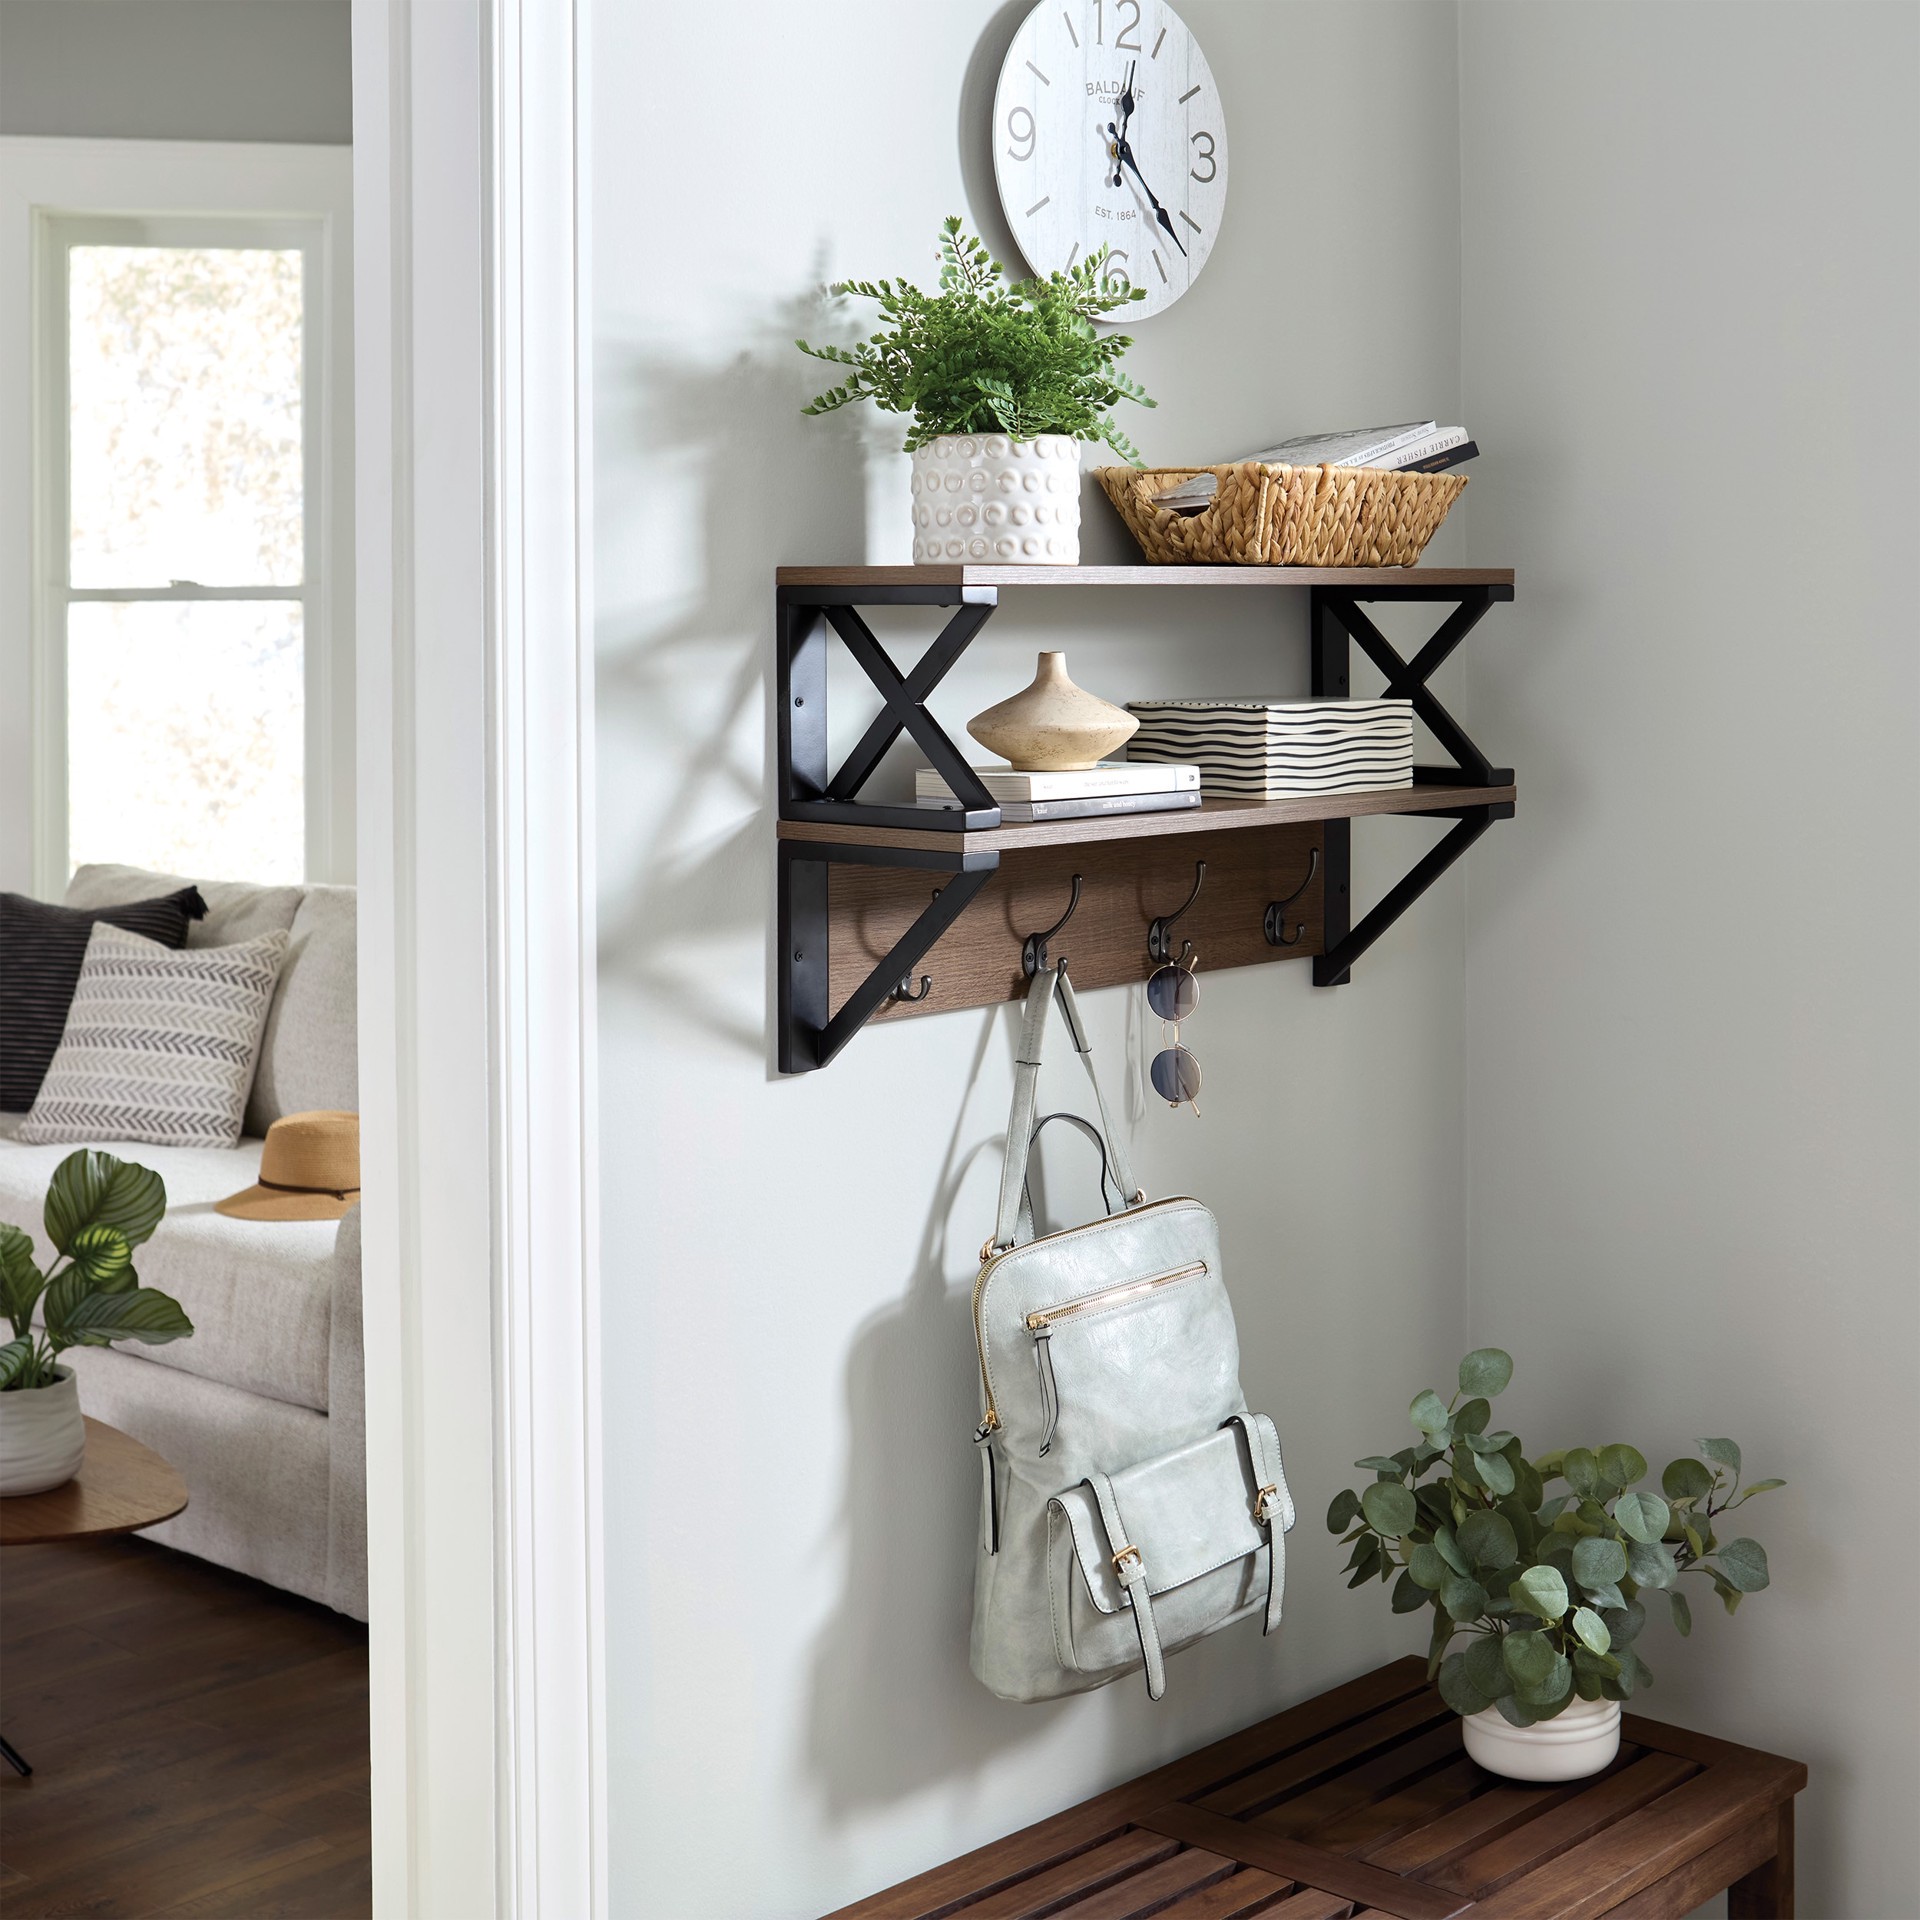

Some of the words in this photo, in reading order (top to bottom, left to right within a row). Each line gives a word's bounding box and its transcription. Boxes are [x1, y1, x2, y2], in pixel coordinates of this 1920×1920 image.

[1092, 0, 1142, 53] 12
[1007, 106, 1036, 162] 9
[1189, 131, 1217, 183] 3
[1094, 205, 1113, 219] EST.
[1116, 209, 1136, 220] 1864
[1102, 249, 1130, 301] 6
[1396, 448, 1428, 465] FISHER
[1431, 434, 1461, 453] CARRIE
